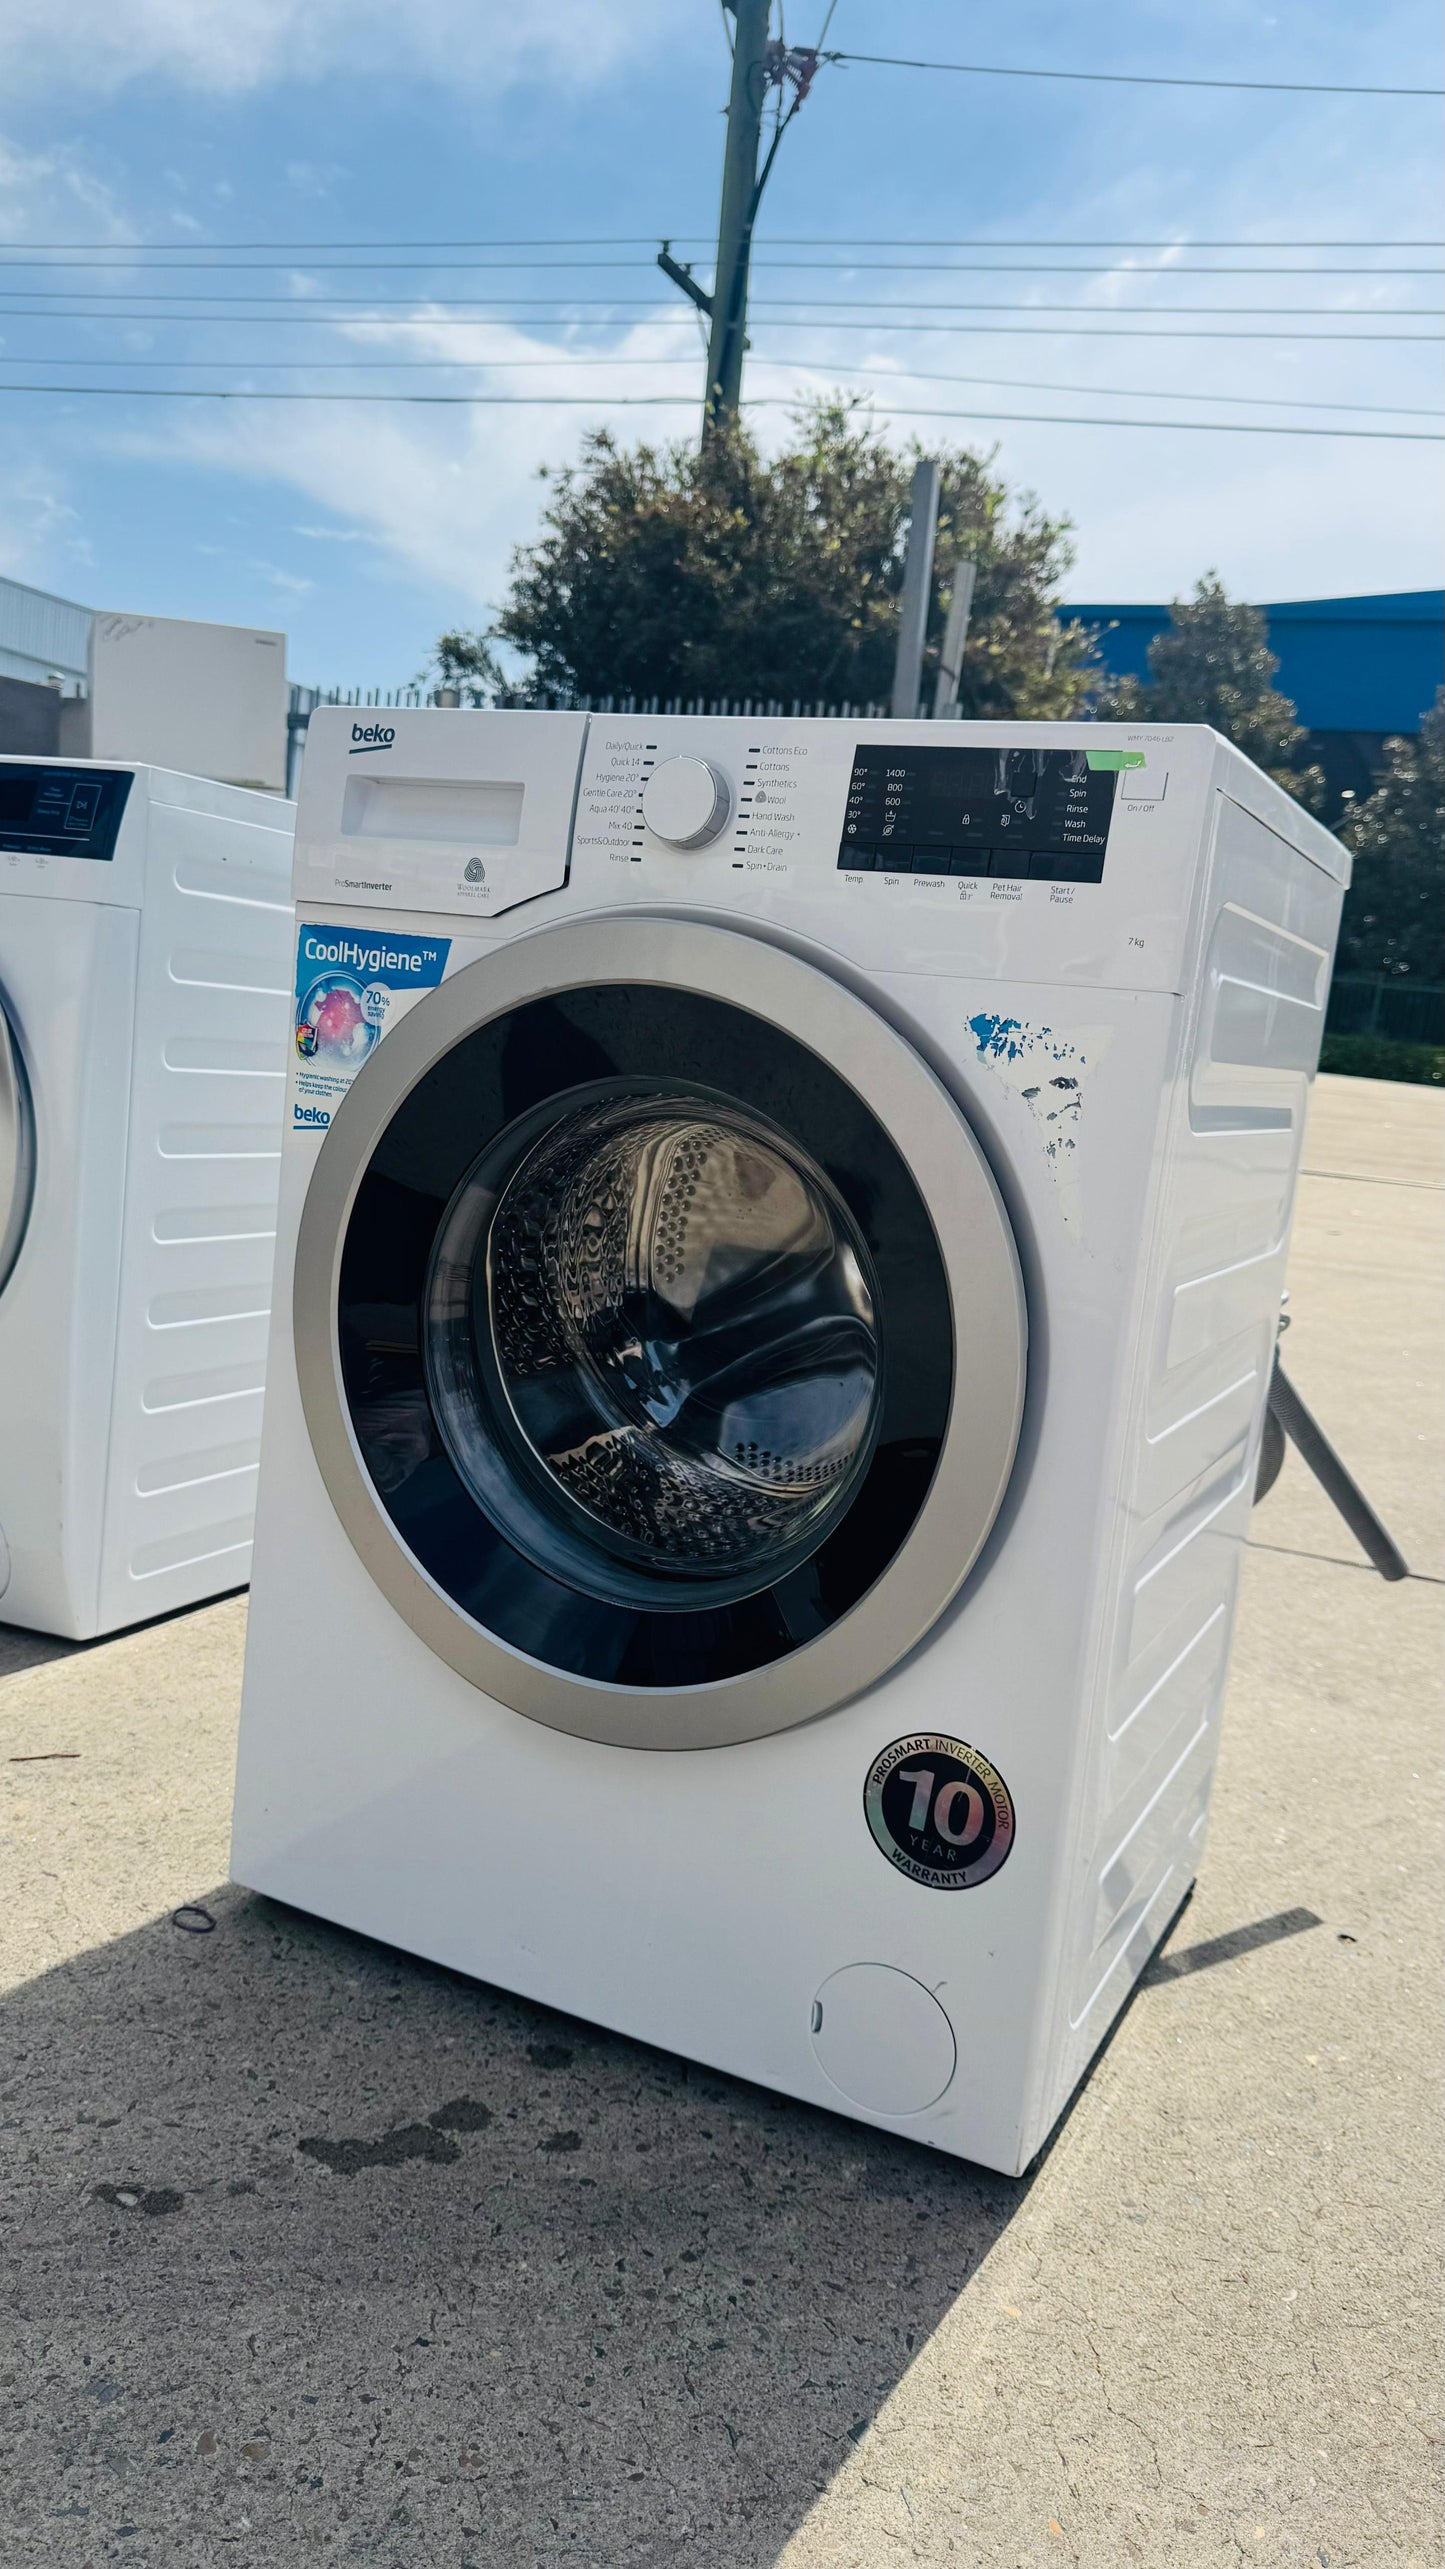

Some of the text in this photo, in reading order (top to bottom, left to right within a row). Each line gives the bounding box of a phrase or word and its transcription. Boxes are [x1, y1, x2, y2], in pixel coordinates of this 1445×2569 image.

[352, 723, 396, 743] beko
[605, 742, 644, 752] Daily/Quick
[762, 746, 808, 756] Cottons Eco
[610, 758, 640, 767] Quick 14
[760, 762, 790, 771] Cottons
[596, 773, 624, 783] Hygiene
[886, 769, 906, 777] 1400
[757, 778, 797, 788] Synthetics
[1071, 774, 1088, 784] End
[583, 788, 606, 797] Gentle
[606, 789, 622, 798] Care
[887, 784, 902, 792] 800
[1069, 789, 1086, 798] Spin
[767, 796, 786, 804] Wool
[885, 798, 900, 806] 600
[589, 804, 608, 814] Aqua
[1066, 804, 1088, 814] Rinse
[1127, 804, 1138, 812] On
[752, 812, 794, 822] Hand Wash
[608, 822, 632, 830] Mix 40
[1064, 820, 1086, 828] Wash
[750, 828, 794, 840] Anti-Allergy
[576, 836, 630, 846] Sports&Outdoor
[1062, 834, 1106, 846] Time Delay
[747, 845, 784, 855] Dark Care
[609, 854, 629, 862] Rinse
[845, 874, 864, 884] Temp
[884, 876, 900, 886] Spin
[914, 878, 946, 888] Prewash
[334, 878, 392, 891] ProSmartInverter
[958, 880, 978, 890] Quick
[992, 882, 1022, 892] Pet Hair
[1050, 886, 1070, 894] Start
[990, 892, 1023, 900] Removal
[1050, 895, 1074, 904] Pause
[1128, 937, 1144, 948] 7 kg
[366, 990, 390, 1006] 70%
[294, 1104, 330, 1124] beko
[872, 1738, 1009, 1830] PROSMART INVERTER MOTOR
[899, 1769, 984, 1846] 10
[910, 1834, 957, 1862] YEAR
[892, 1848, 967, 1884] WARRANTY
